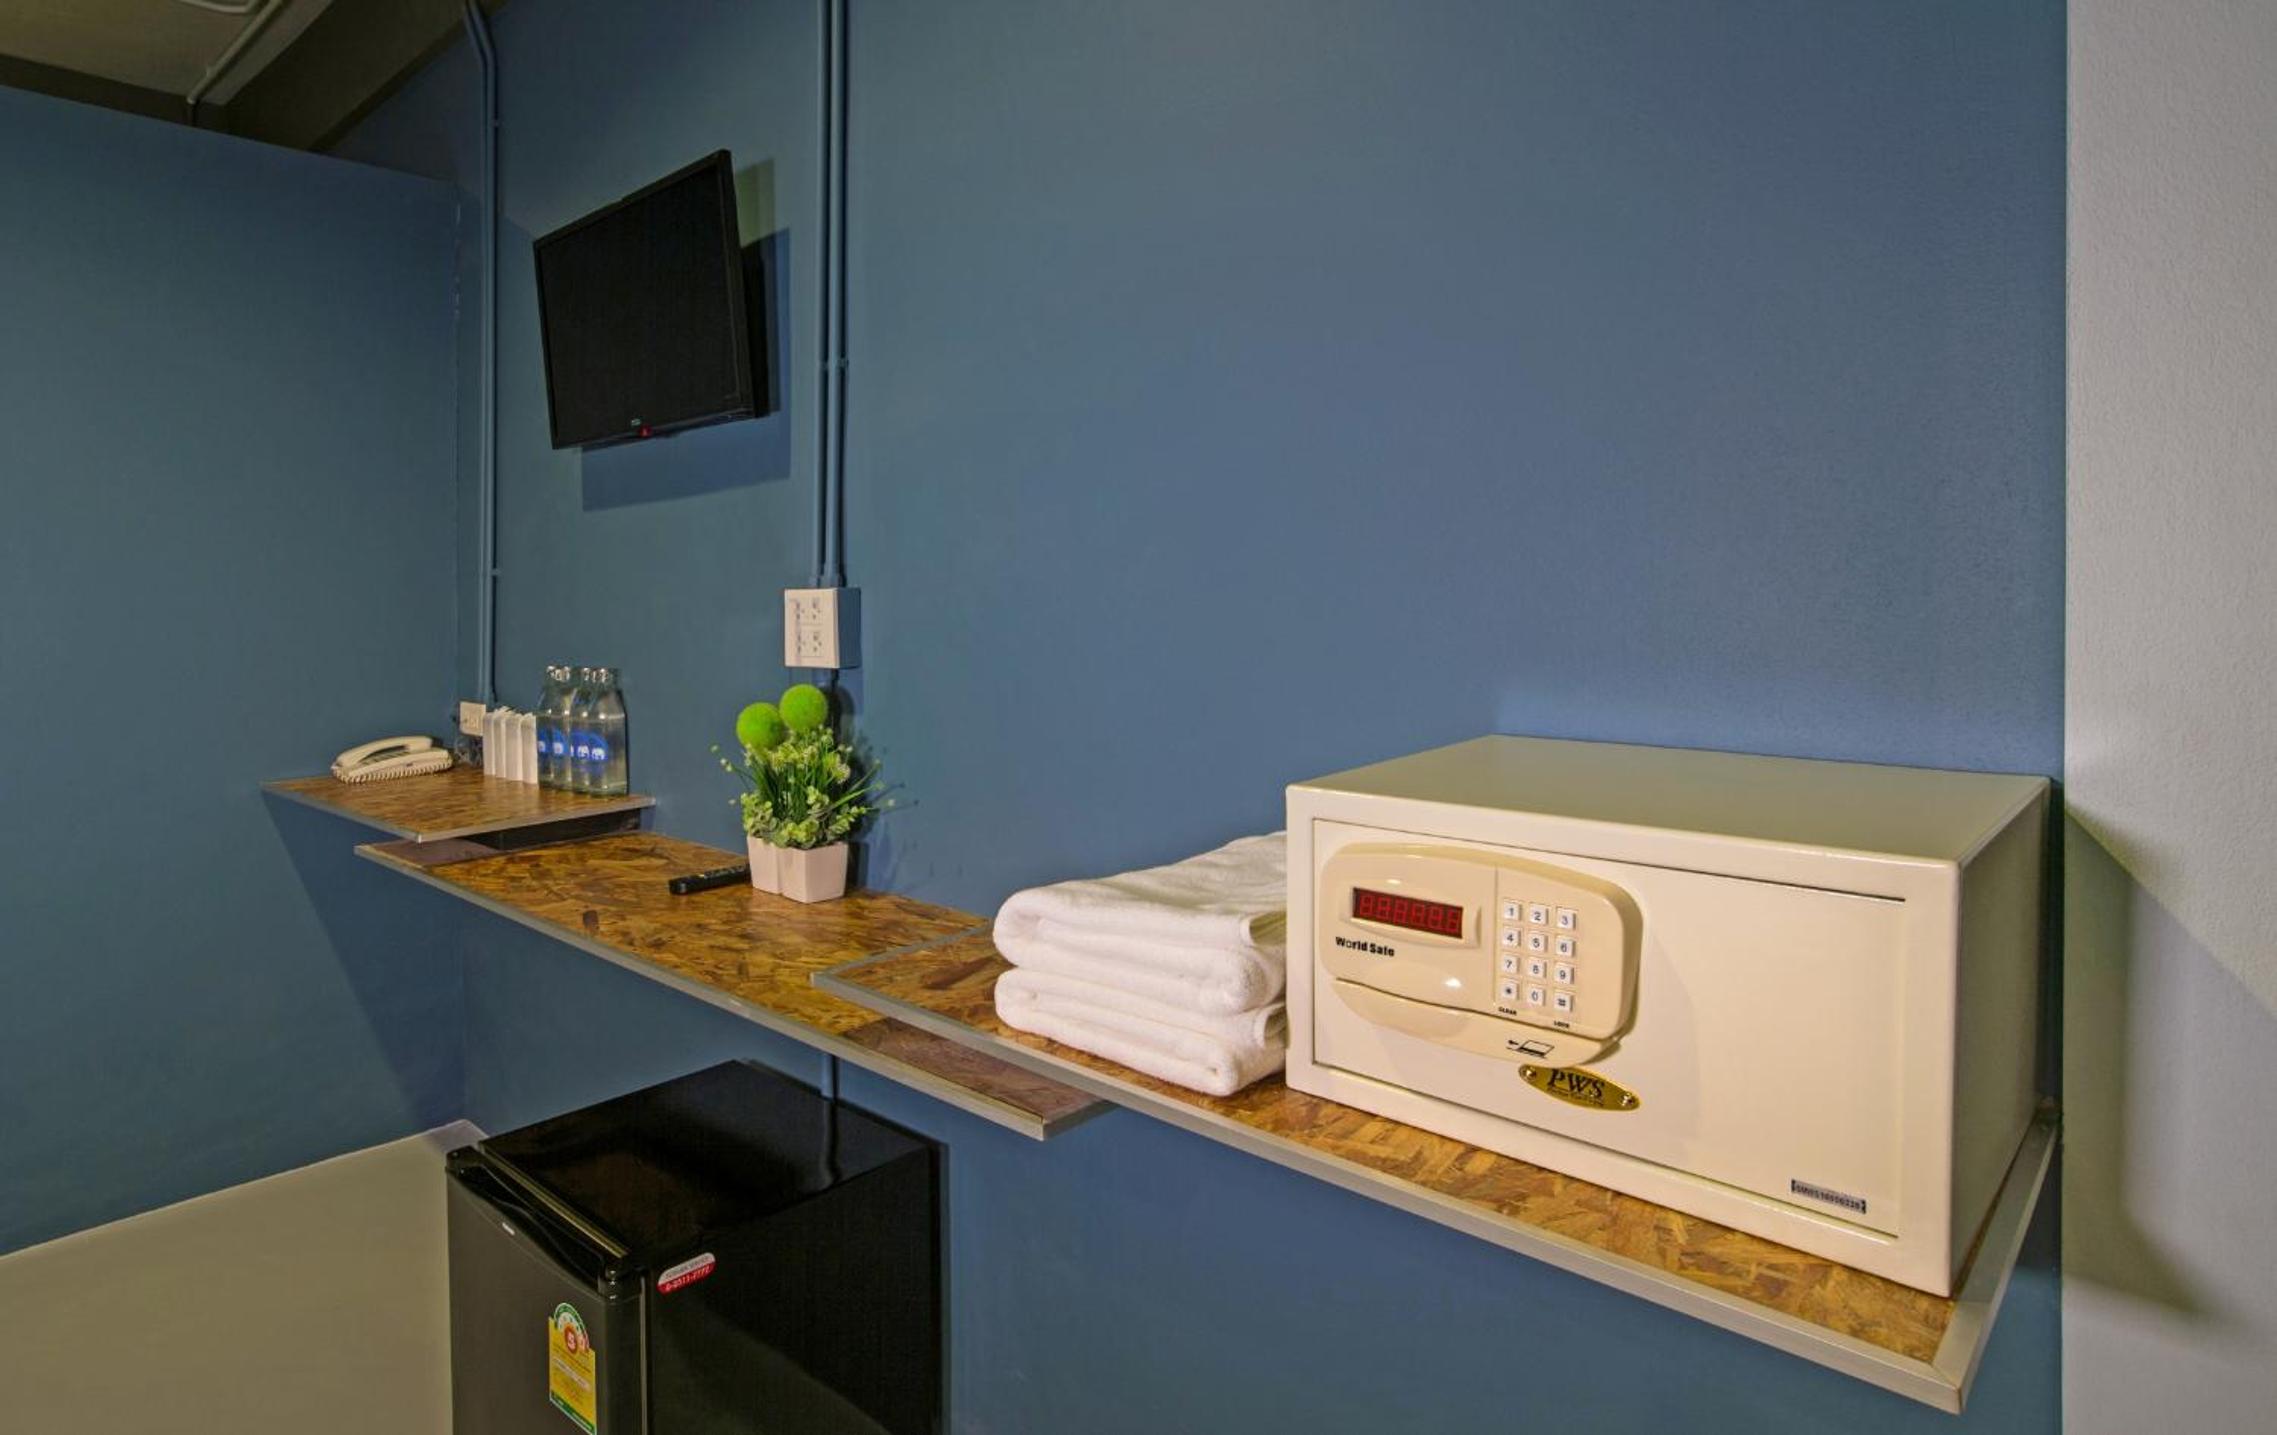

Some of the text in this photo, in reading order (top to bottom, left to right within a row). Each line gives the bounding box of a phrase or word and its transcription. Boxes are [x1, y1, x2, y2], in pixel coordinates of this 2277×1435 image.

[1508, 907, 1569, 926] 1 2 3
[1335, 936, 1395, 957] World Safe
[1506, 933, 1568, 953] 4 5 6
[1505, 959, 1566, 980] 7 8 9
[1531, 990, 1539, 1001] 0
[1548, 1068, 1605, 1098] PWS
